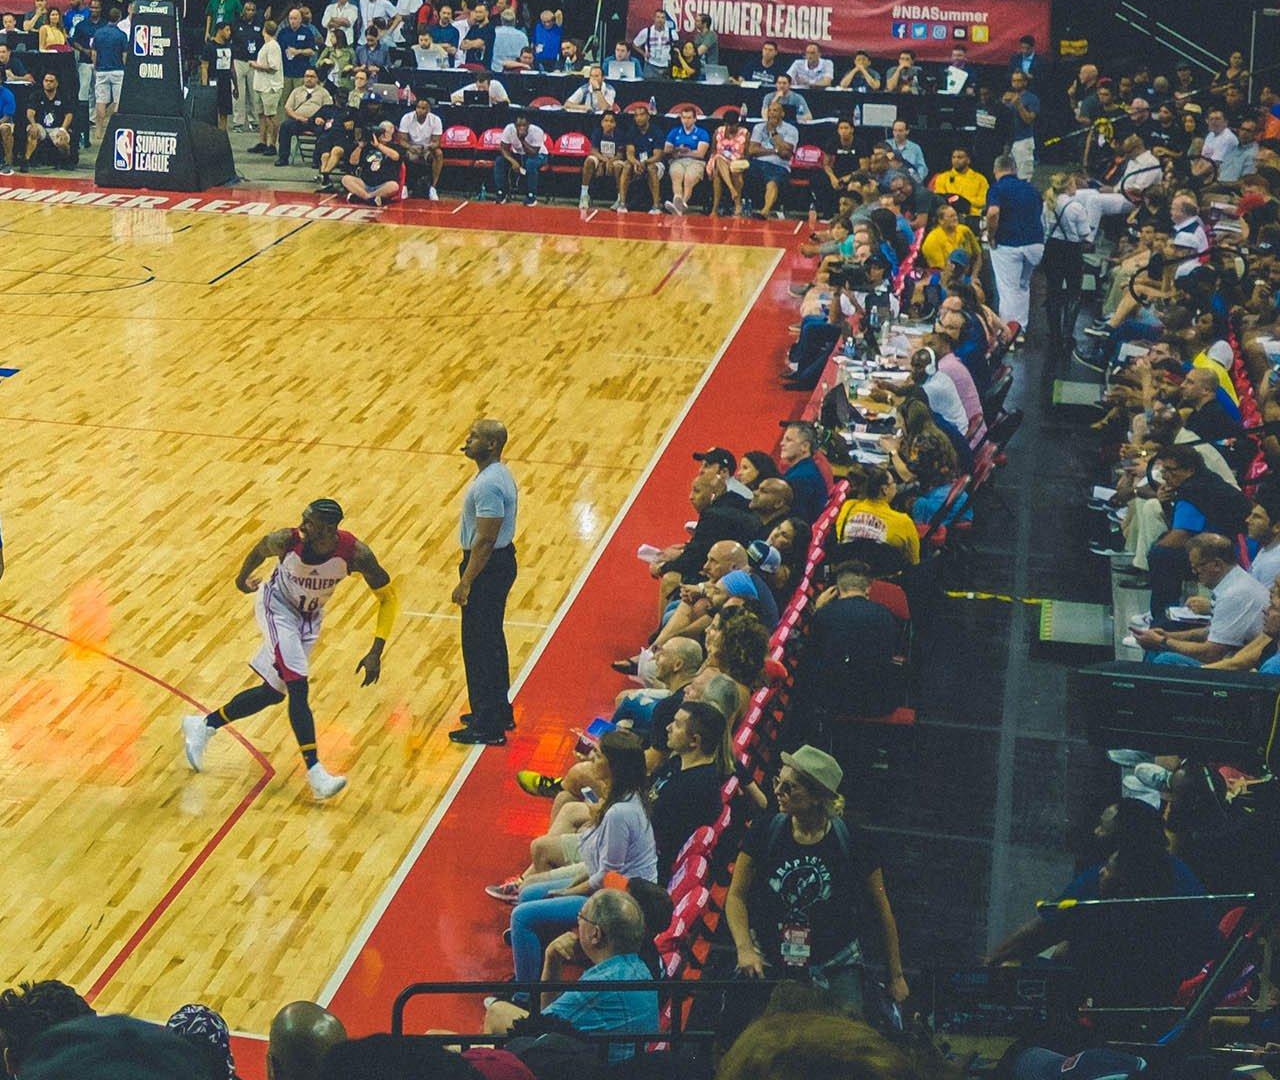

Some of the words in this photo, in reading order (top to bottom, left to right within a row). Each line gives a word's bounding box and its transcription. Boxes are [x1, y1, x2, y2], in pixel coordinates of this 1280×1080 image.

[766, 3, 833, 41] LEAGUE
[892, 5, 989, 23] #NBASummer
[136, 135, 177, 155] SUMMER
[135, 153, 169, 172] LEAGUE
[169, 197, 384, 222] LEAGUE
